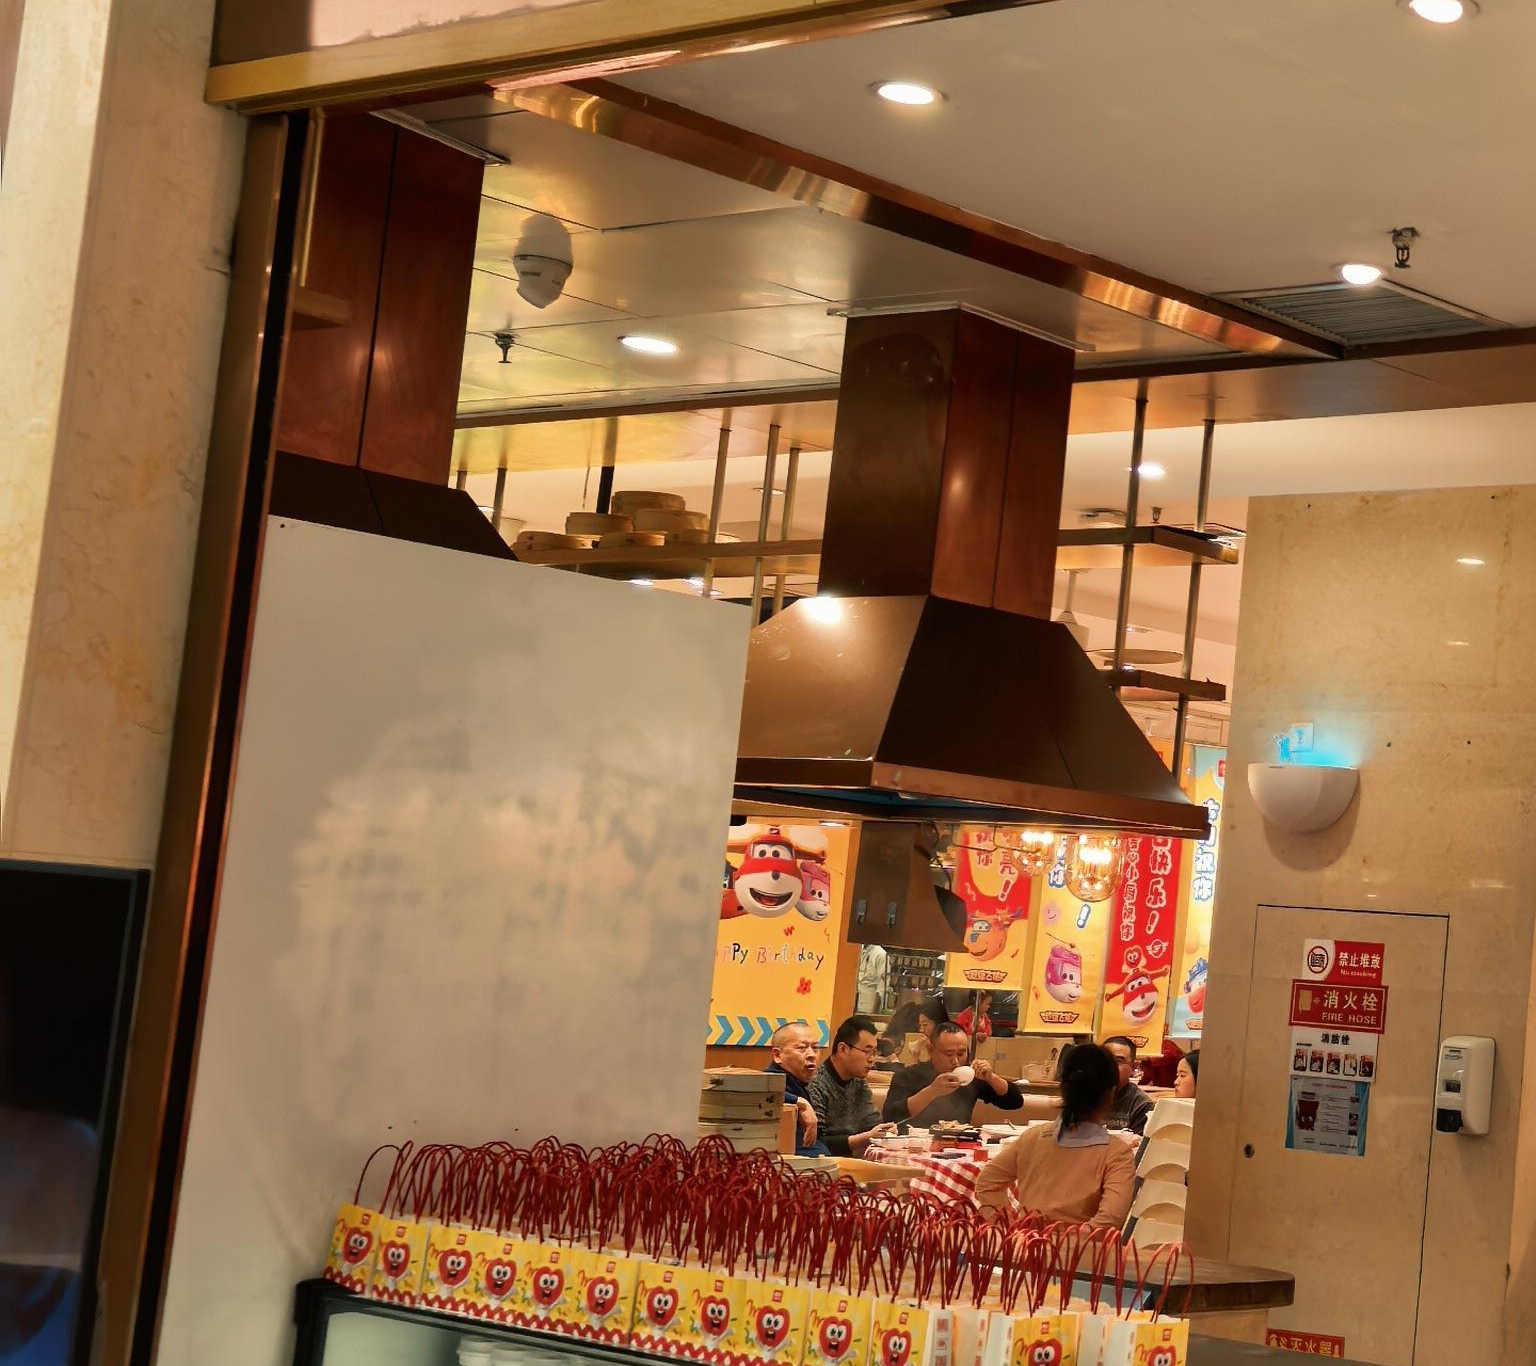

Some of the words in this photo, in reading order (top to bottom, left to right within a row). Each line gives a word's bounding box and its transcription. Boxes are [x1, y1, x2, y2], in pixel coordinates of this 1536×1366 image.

[1323, 989, 1378, 1012] 消火栓
[1321, 1012, 1343, 1023] FIRE
[1348, 1014, 1377, 1025] HOSE
